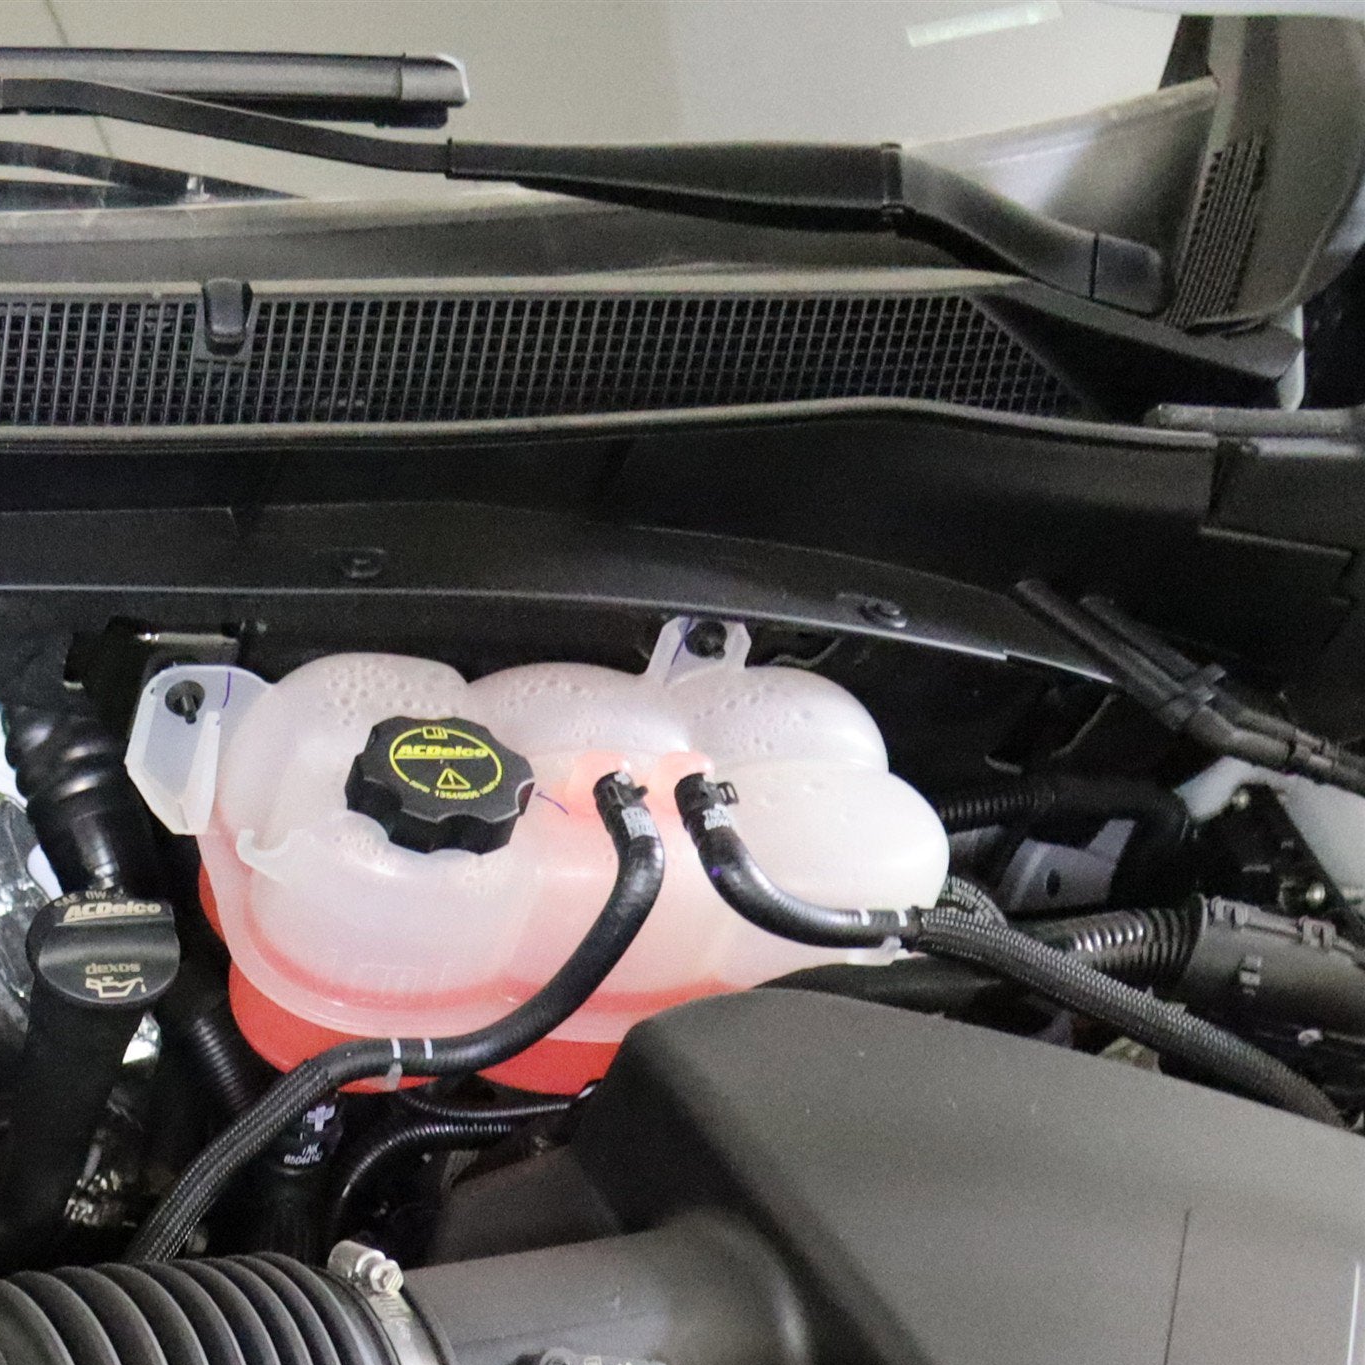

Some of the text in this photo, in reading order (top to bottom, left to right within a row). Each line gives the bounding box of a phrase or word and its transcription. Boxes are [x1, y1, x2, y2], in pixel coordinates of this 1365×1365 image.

[395, 744, 489, 759] ACDelco
[64, 901, 162, 922] ACDelco
[85, 963, 141, 975] dexos
